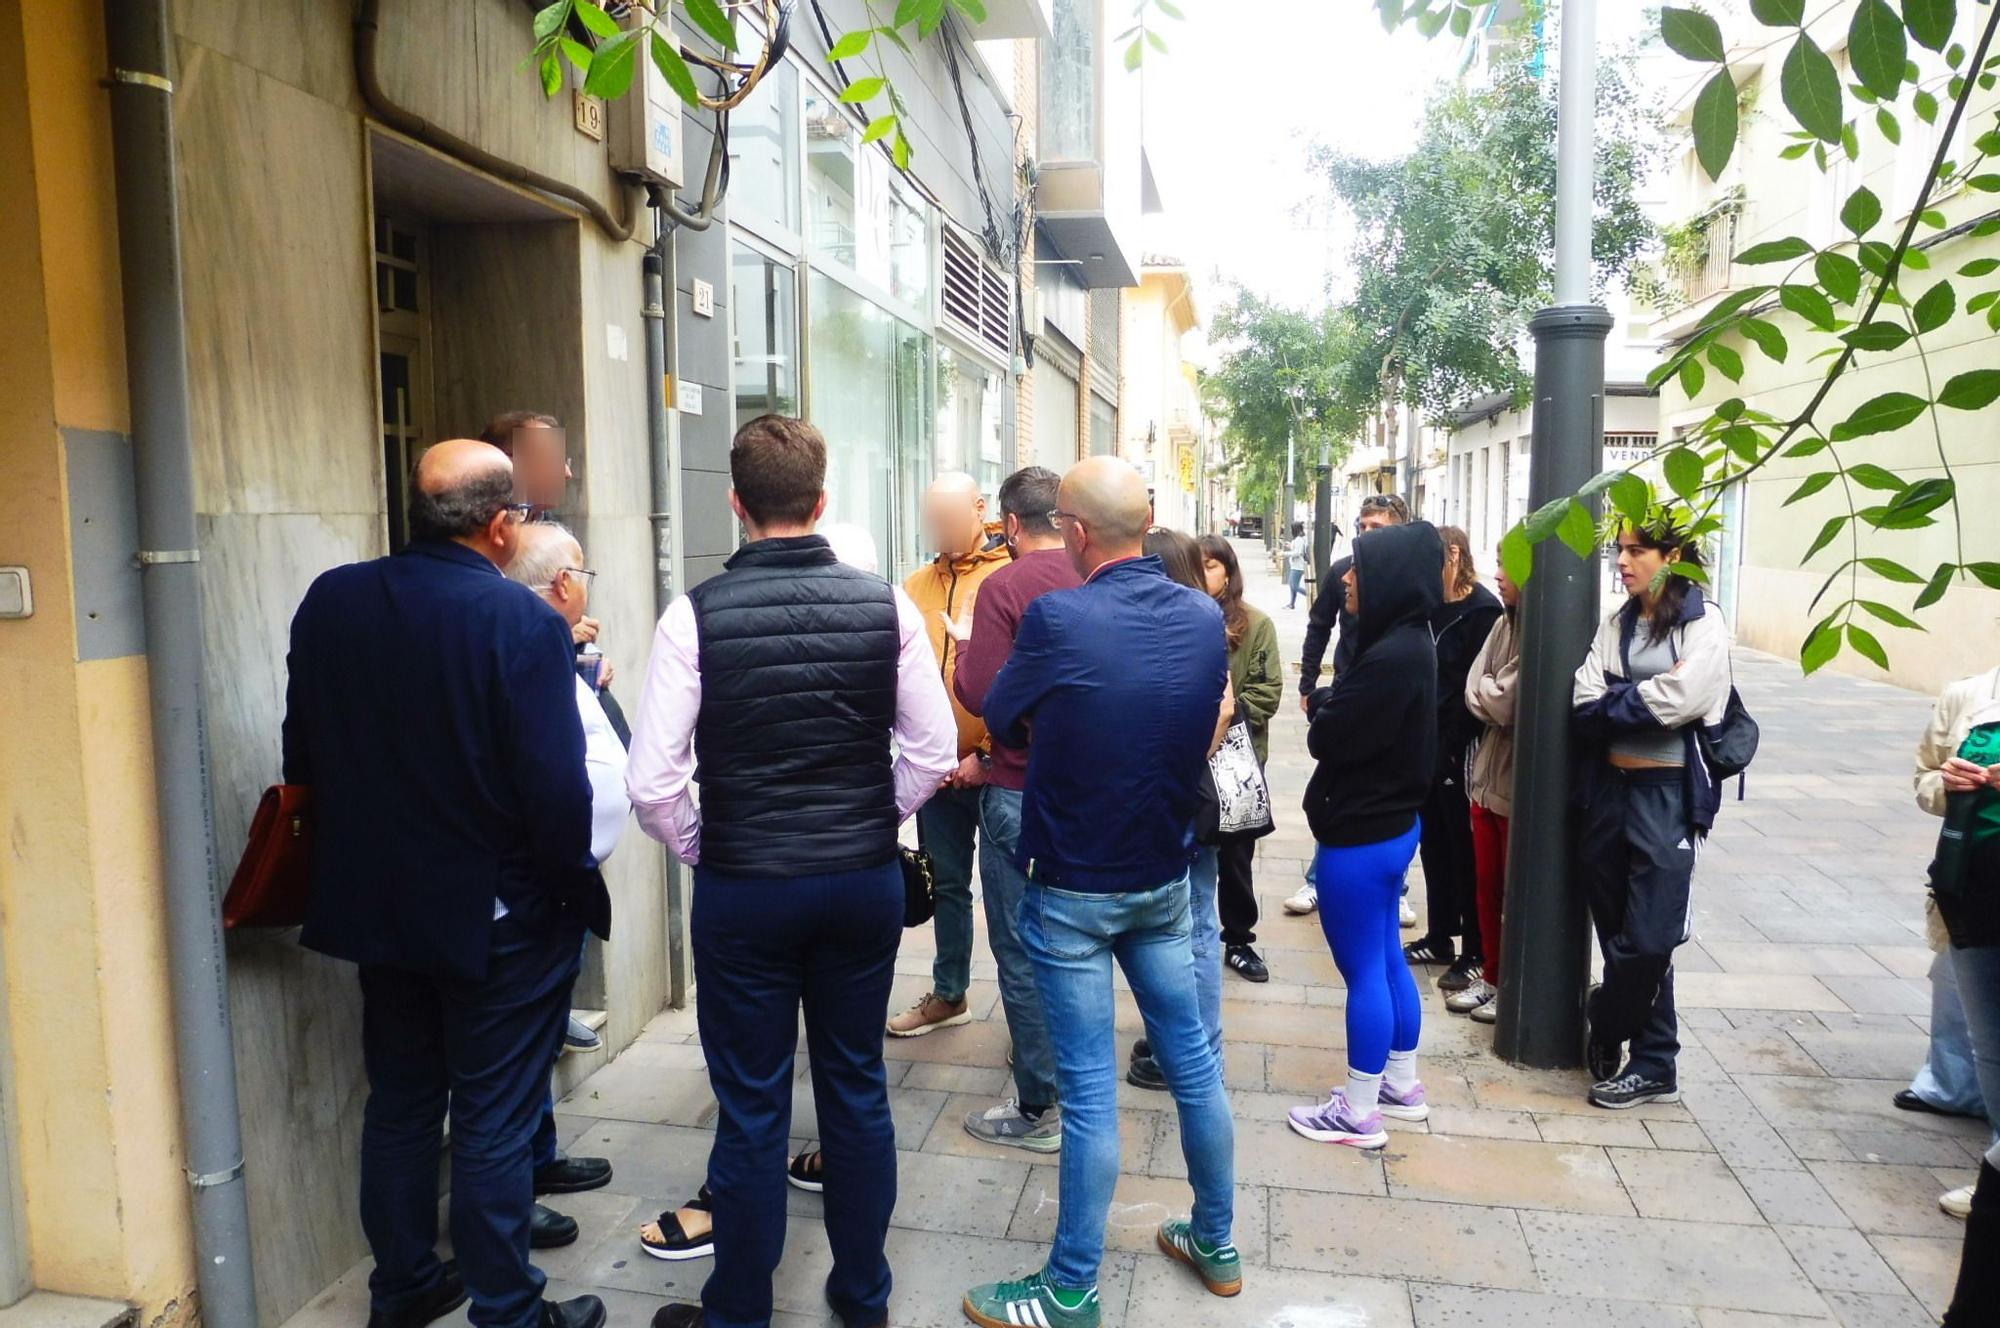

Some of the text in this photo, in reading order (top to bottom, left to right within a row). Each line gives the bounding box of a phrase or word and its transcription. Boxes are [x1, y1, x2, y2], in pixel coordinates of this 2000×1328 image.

[581, 102, 598, 129] 19
[699, 287, 710, 310] 21
[1610, 450, 1656, 461] VEND
